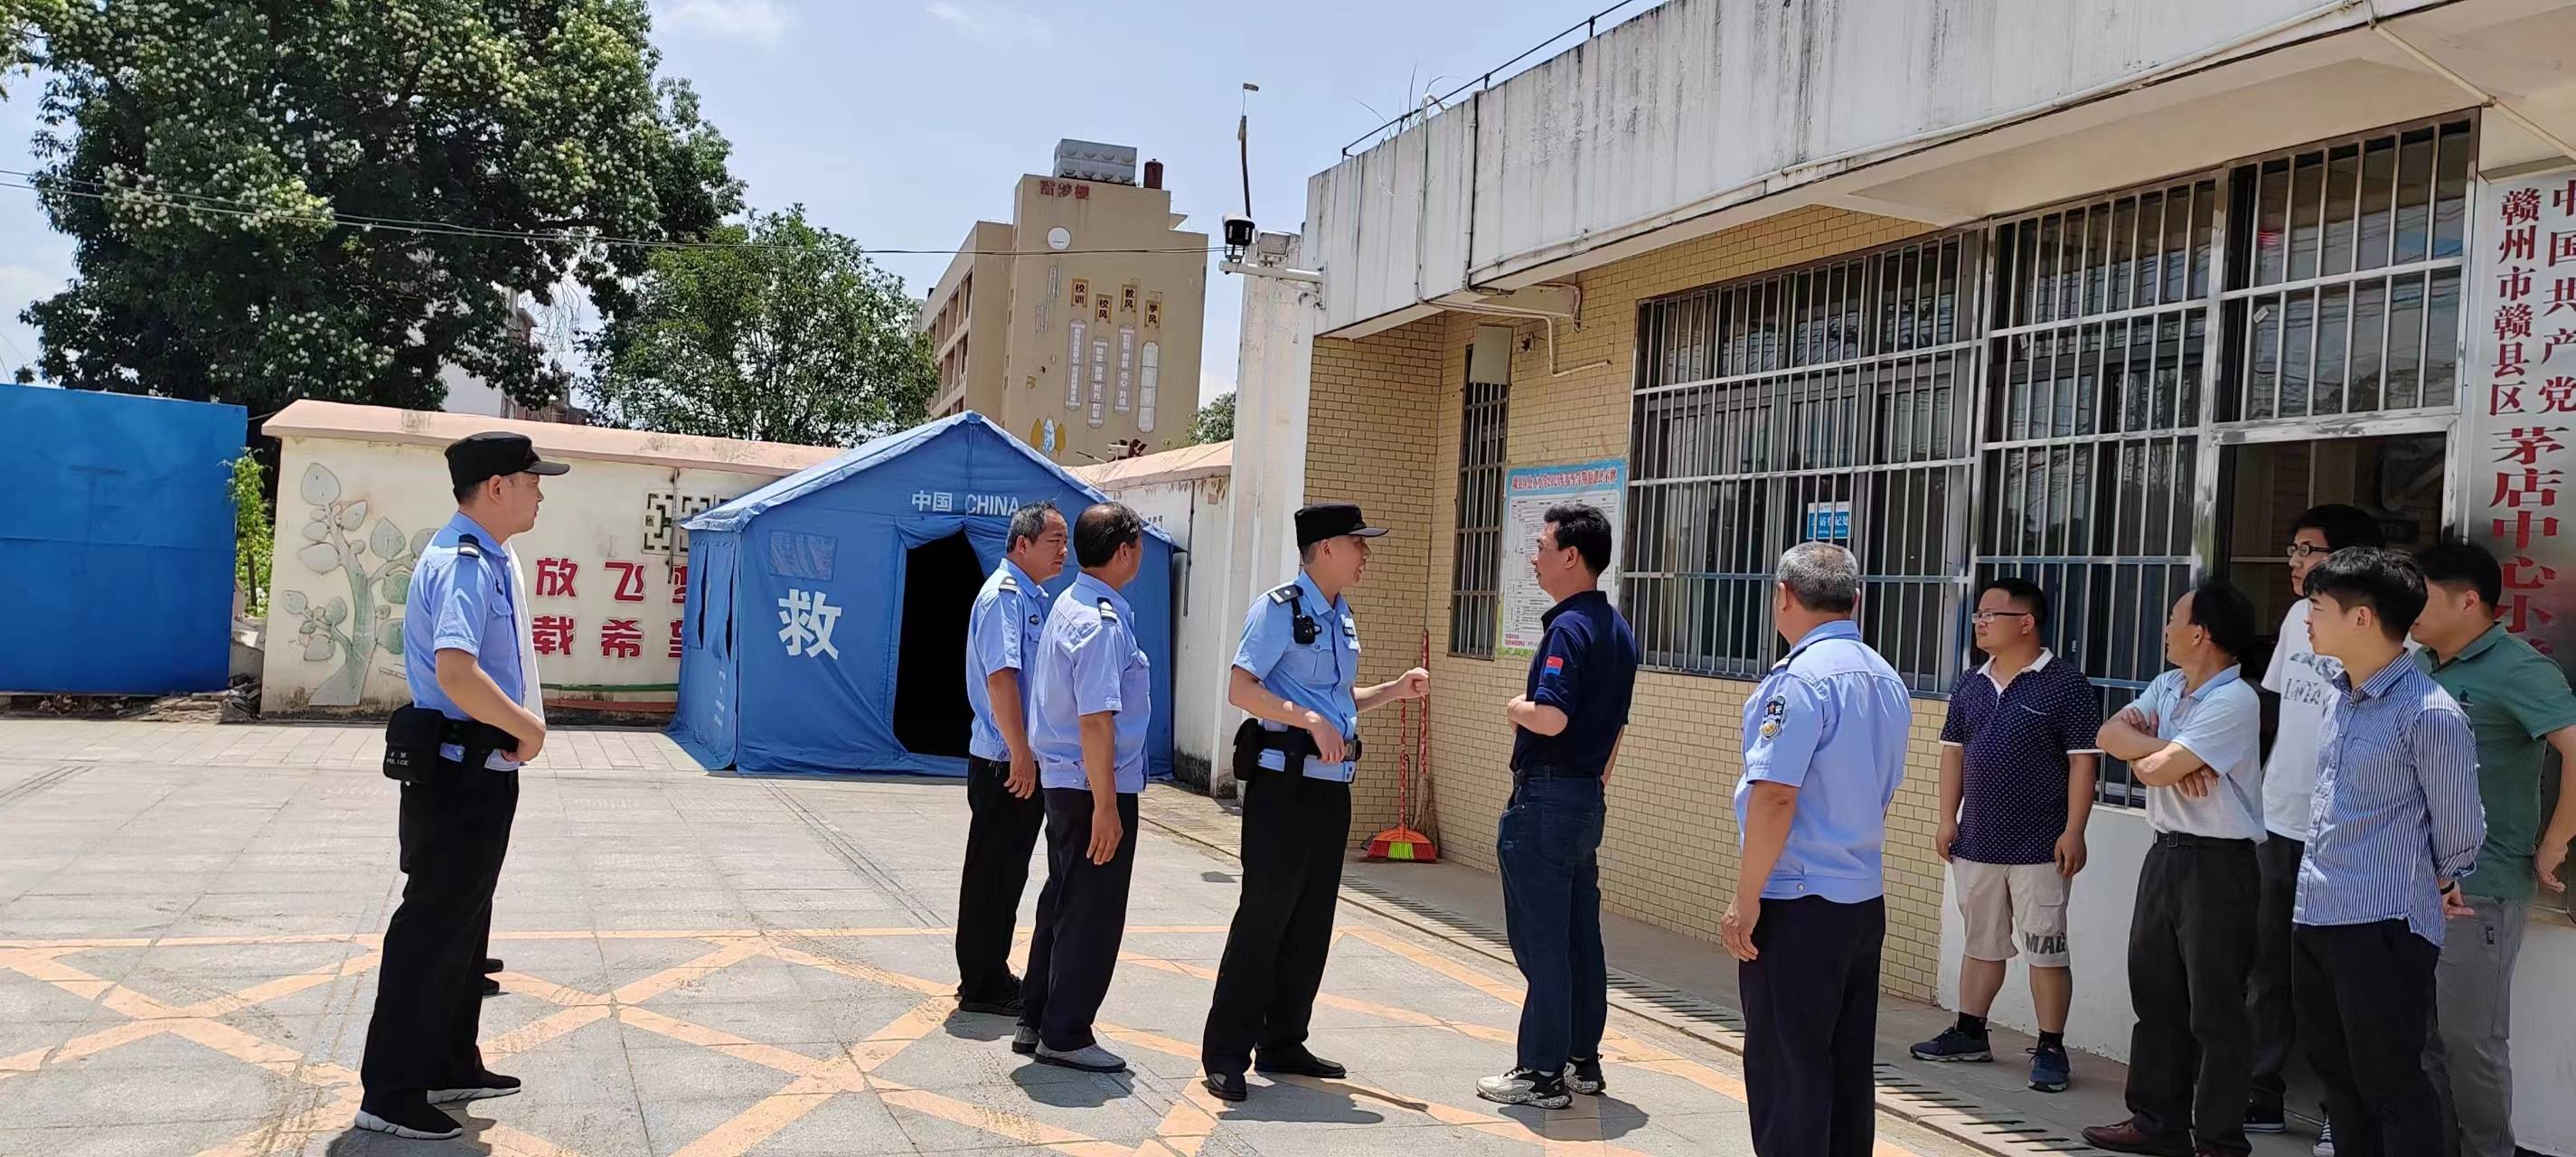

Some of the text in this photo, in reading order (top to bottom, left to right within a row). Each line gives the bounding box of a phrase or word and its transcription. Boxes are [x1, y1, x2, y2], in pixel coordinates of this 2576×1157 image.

[1075, 283, 1086, 305] 校训
[1123, 288, 1135, 309] 教风
[2488, 187, 2541, 417] 赣州市赣县区
[1098, 298, 1109, 319] 校风
[1148, 303, 1158, 324] 学风
[911, 489, 953, 513] 中国
[964, 494, 1020, 516] CHINA
[2489, 426, 2570, 654] 茅店中心小
[778, 588, 841, 661] 救
